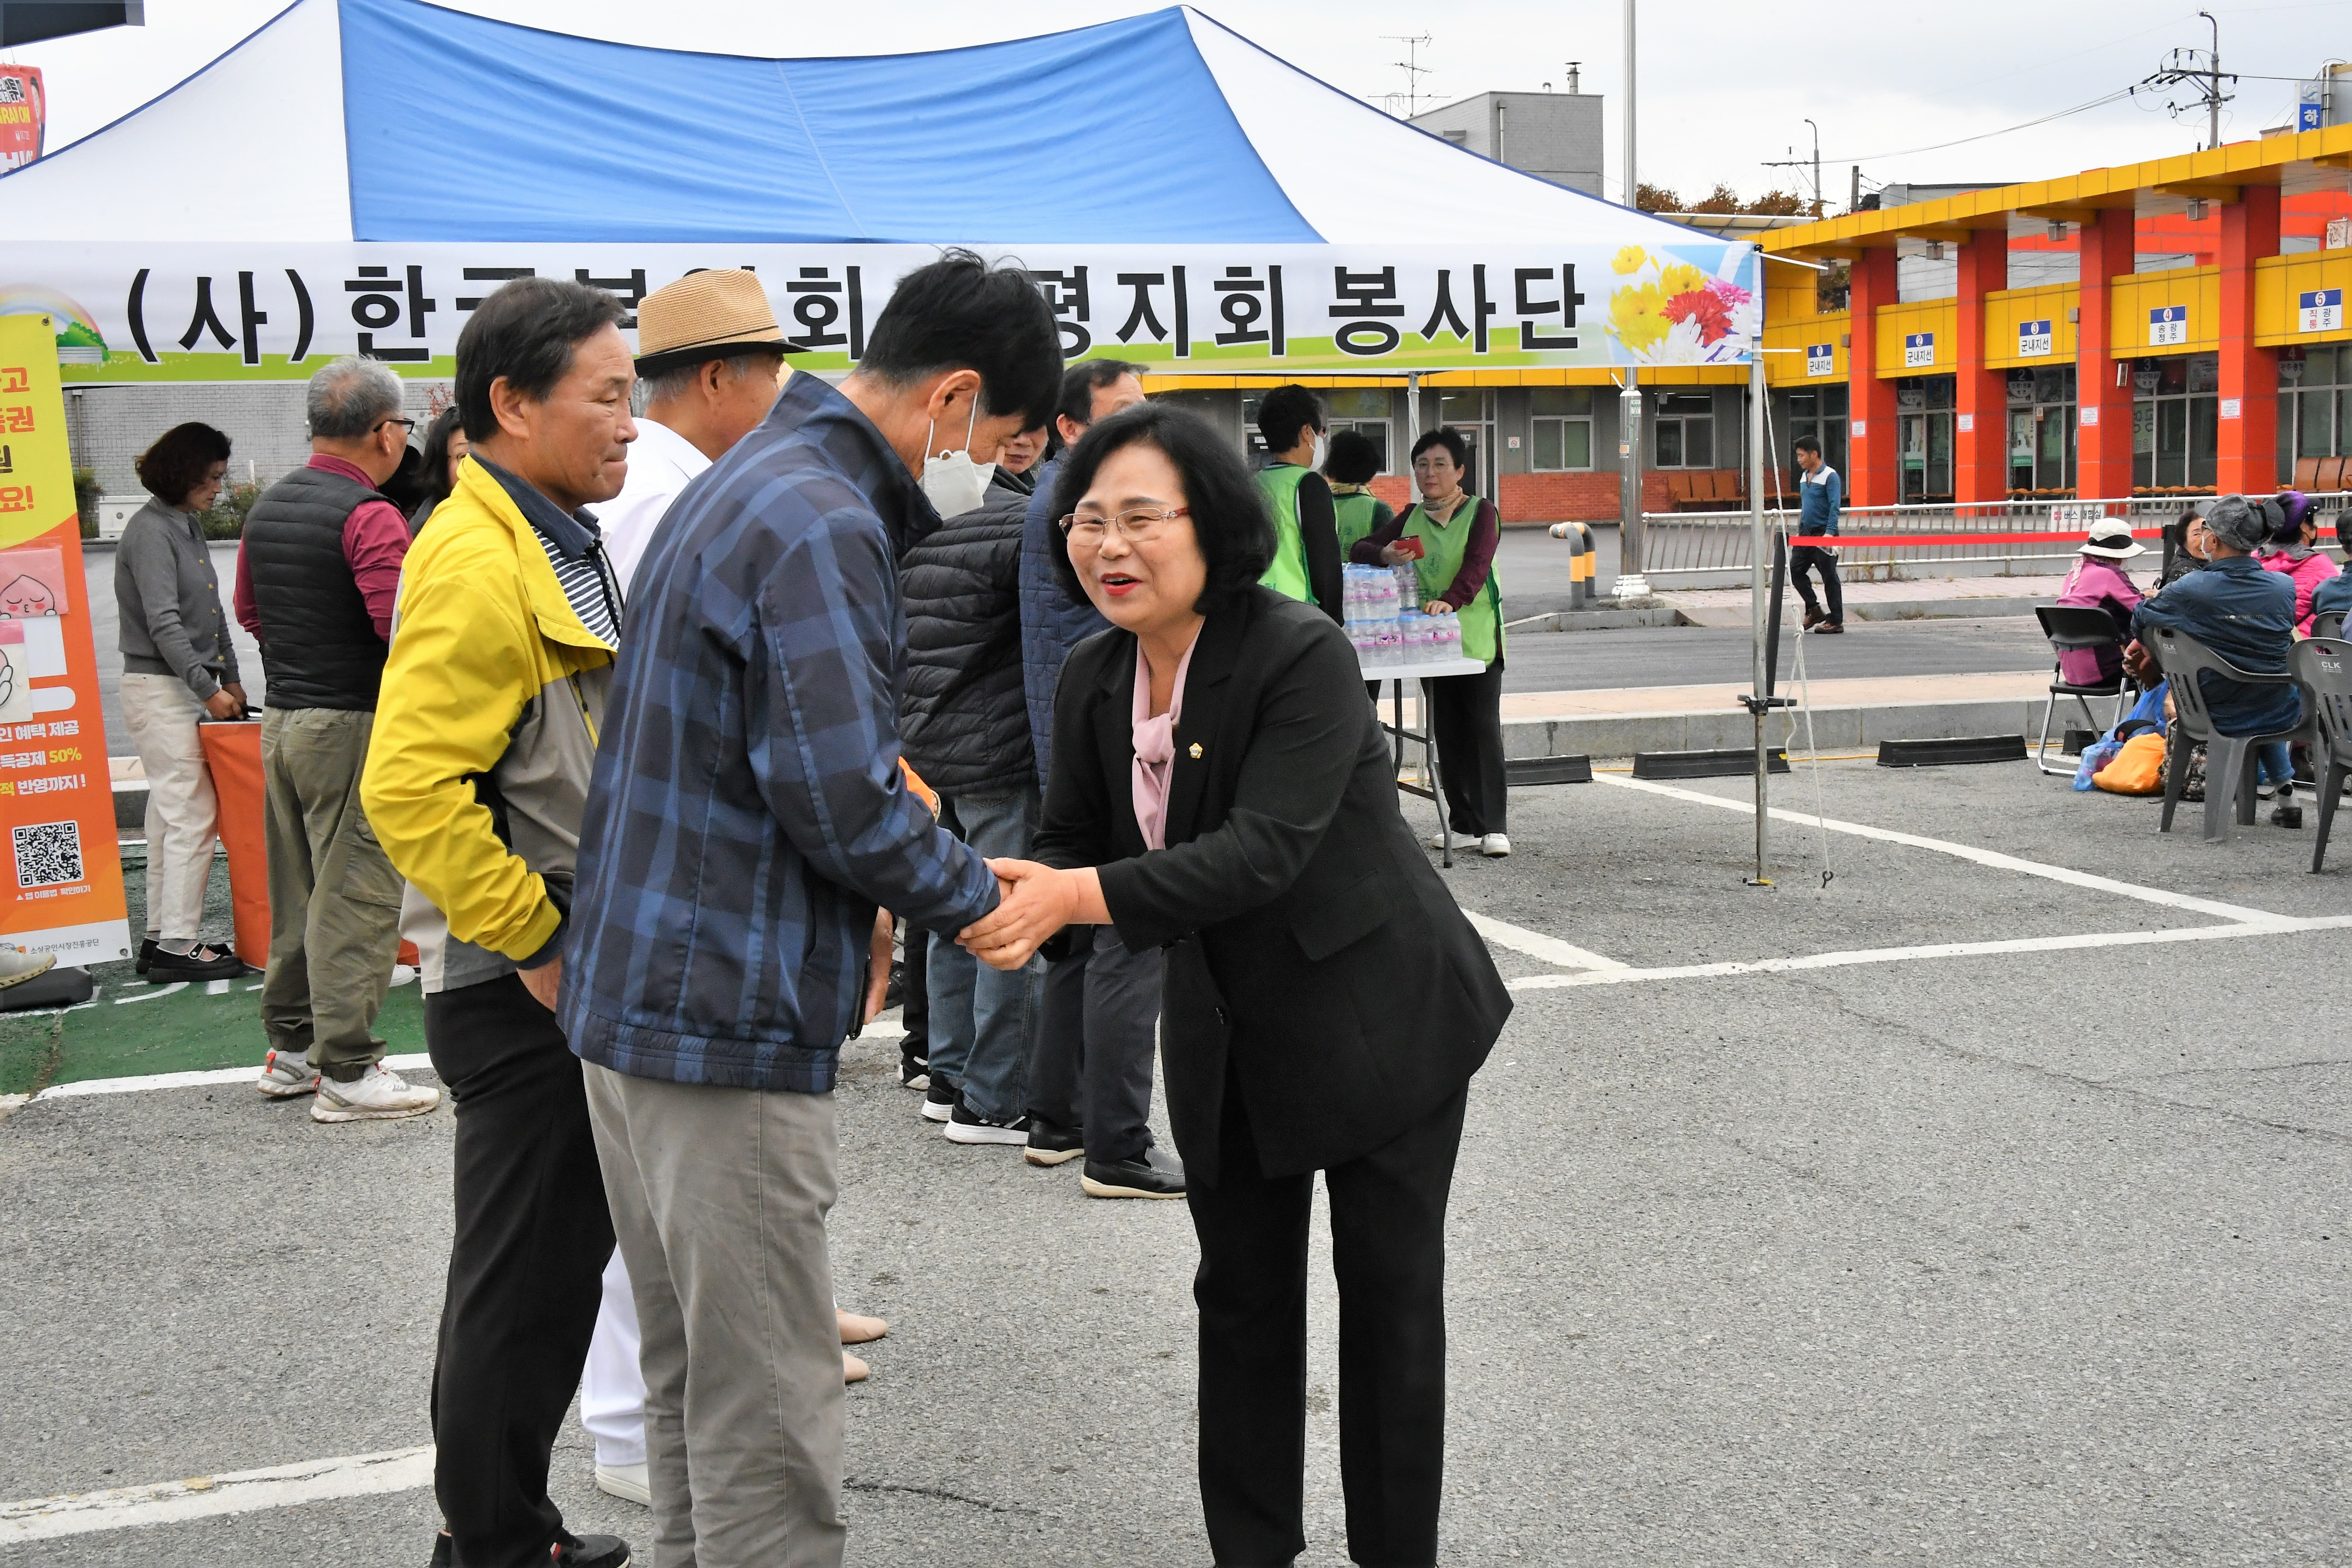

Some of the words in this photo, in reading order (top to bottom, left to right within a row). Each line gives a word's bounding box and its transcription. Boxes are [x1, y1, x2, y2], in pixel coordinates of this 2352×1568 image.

[2304, 109, 2318, 131] 하
[2318, 294, 2323, 305] 5
[1029, 265, 1287, 359] 평지회
[1328, 262, 1586, 356] 봉사단
[2165, 310, 2170, 320] 4
[2309, 310, 2317, 329] 직통
[2322, 308, 2331, 327] 광주
[2032, 324, 2037, 333] 3
[2158, 324, 2166, 343] 송정
[2169, 323, 2178, 341] 광주
[1917, 336, 1922, 346] 2
[2021, 338, 2049, 352] 군내지선
[1818, 347, 1822, 356] 1
[1907, 350, 1932, 362] 군내지선
[2289, 347, 2296, 360] 4
[1809, 360, 1831, 372] 군내지선
[2144, 358, 2151, 371] 3
[0, 367, 30, 393] 고
[2018, 368, 2025, 381] 2
[1908, 378, 1913, 389] 1
[0, 406, 35, 434] 권
[0, 485, 34, 513] 요!
[2064, 510, 2078, 520] 버스
[0, 727, 13, 742] 인
[15, 723, 46, 740] 혜택
[48, 720, 79, 736] 제공
[49, 747, 82, 763] 50%
[0, 781, 15, 796] 적
[60, 885, 91, 895] 확인하기
[30, 939, 99, 955] 소상공인시장진흥공단
